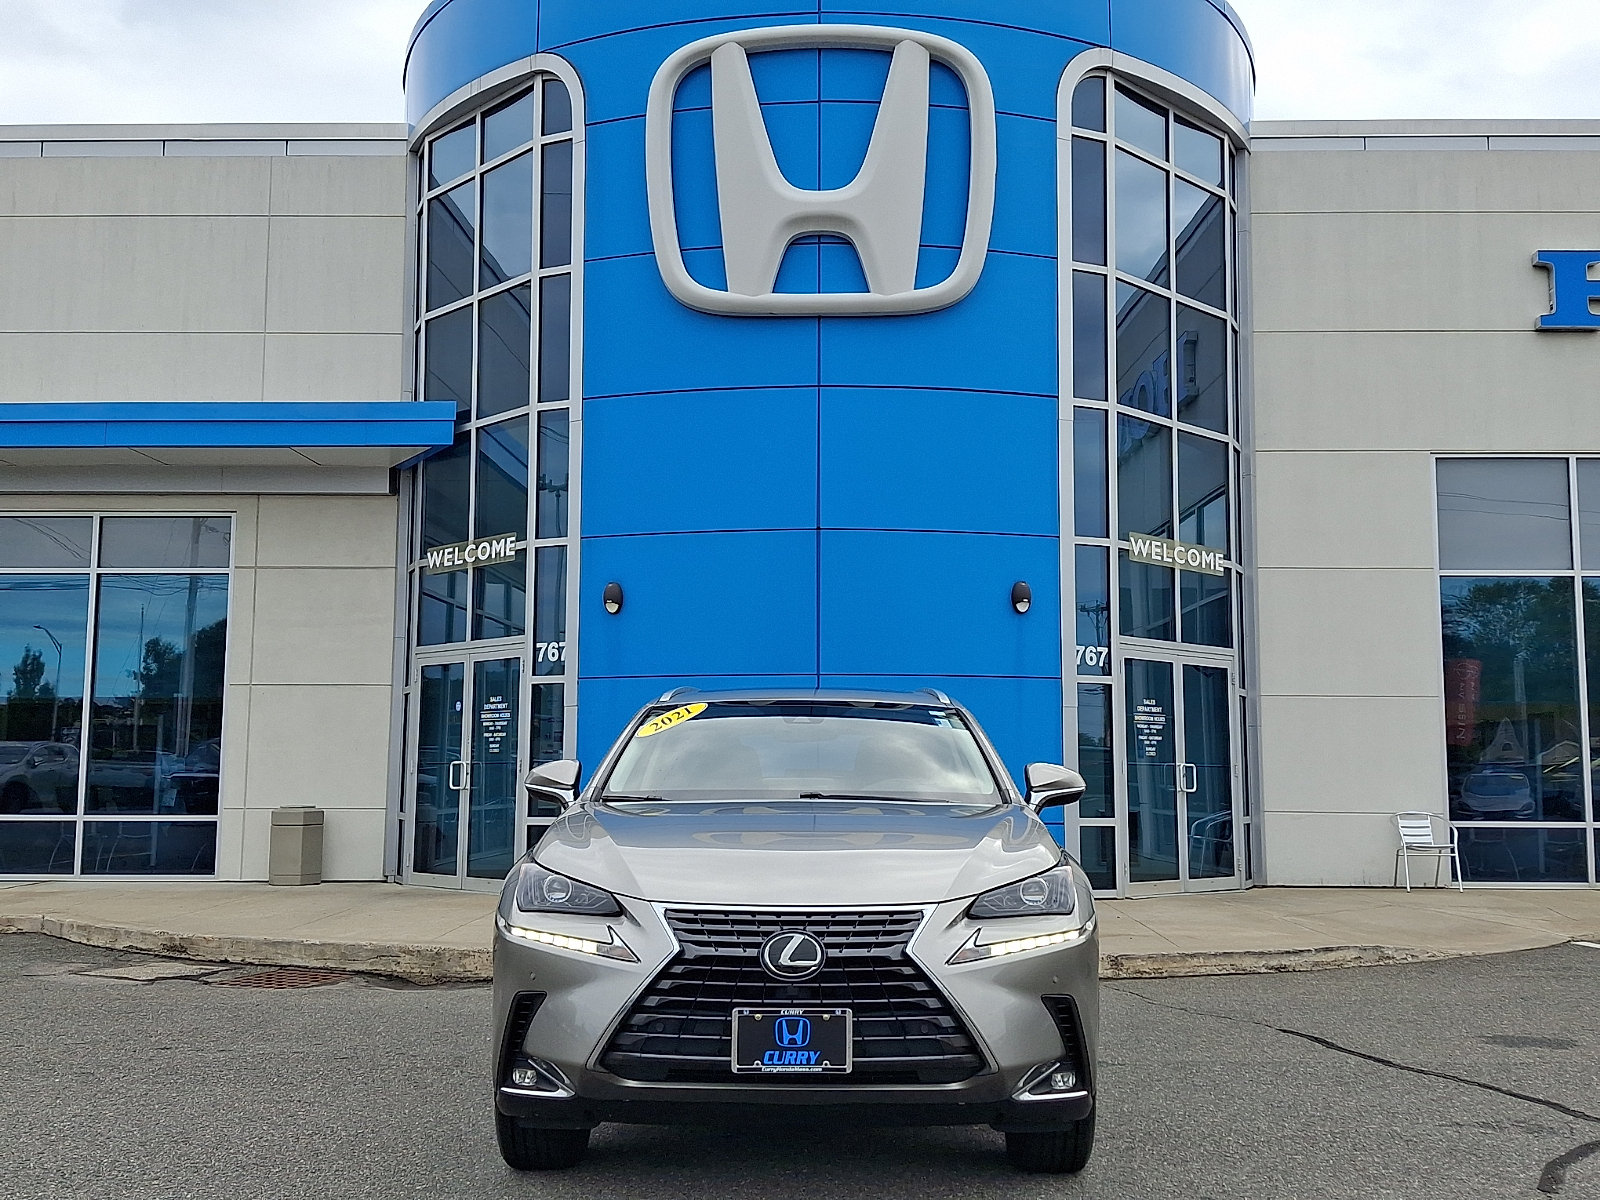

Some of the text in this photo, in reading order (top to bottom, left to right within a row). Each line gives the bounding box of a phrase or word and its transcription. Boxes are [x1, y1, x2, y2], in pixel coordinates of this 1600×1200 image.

[427, 537, 516, 569] WELCOME
[1130, 536, 1224, 572] WELCOME
[536, 641, 566, 663] 767
[1075, 645, 1108, 667] 767
[649, 707, 693, 731] 2021
[763, 1051, 820, 1064] CURRY
